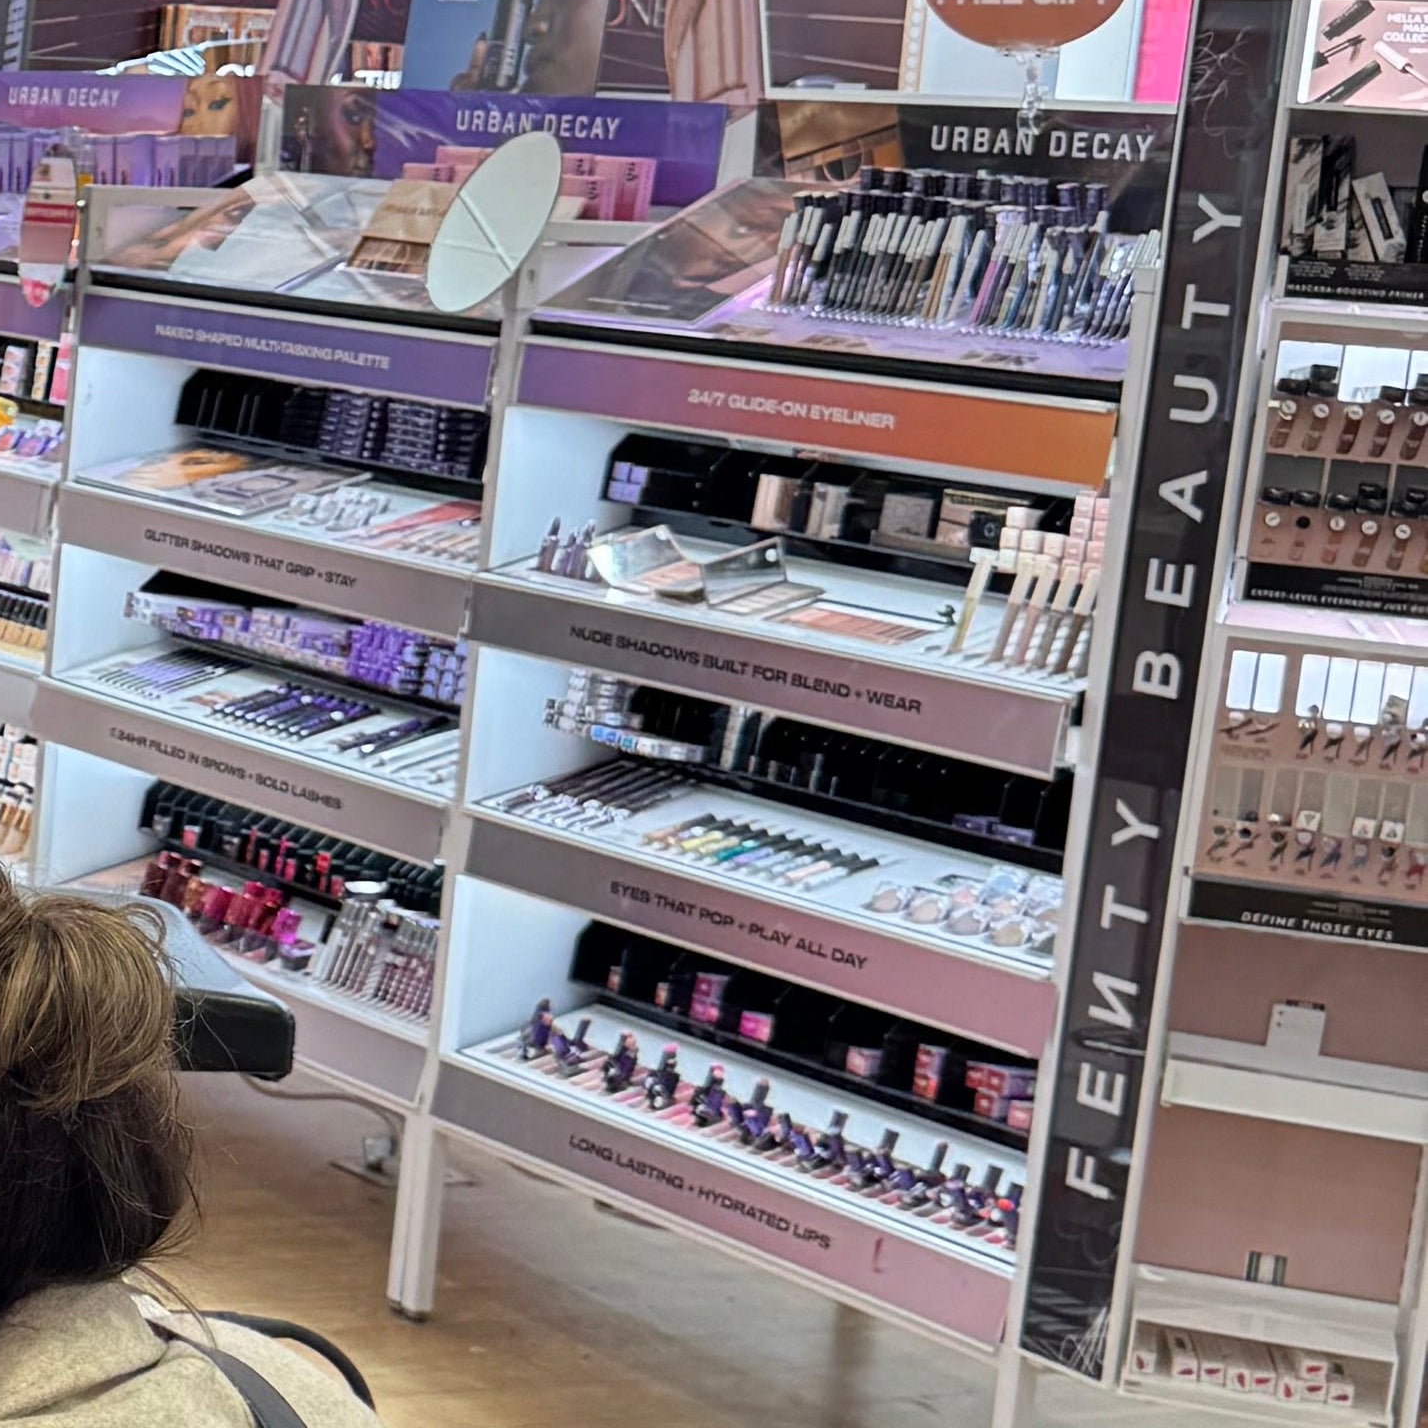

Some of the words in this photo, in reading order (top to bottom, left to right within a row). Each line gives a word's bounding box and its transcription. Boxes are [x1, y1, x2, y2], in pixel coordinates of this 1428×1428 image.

[8, 86, 63, 105] URBAN
[67, 88, 121, 107] DECAY
[455, 108, 538, 135] URBAN
[543, 113, 621, 141] DECAY
[930, 124, 1034, 157] URBAN
[1047, 129, 1156, 162] DECAY
[155, 324, 194, 341] NAKED
[196, 329, 242, 347] SHAPED
[334, 350, 390, 369] PALETTE
[687, 388, 725, 406] 24/7
[728, 394, 808, 418] GLIDE-ON
[810, 404, 896, 430] EYELINER
[1131, 193, 1244, 701] BEAUTY
[144, 528, 190, 549] GLITTER
[191, 538, 252, 563] SHADOWS
[253, 553, 284, 571] THAT
[285, 562, 316, 578] GRIP
[324, 571, 357, 588] STAY
[569, 625, 613, 647] NUDE
[615, 634, 700, 666] SHADOWS
[702, 653, 749, 676] BUILT
[751, 664, 788, 684] FOR
[790, 672, 851, 699] BLEND
[866, 689, 923, 714] WEAR
[148, 739, 186, 760] FILLED
[201, 756, 246, 780] BROWS
[291, 785, 343, 810] LASHES
[611, 881, 651, 904] EYES
[654, 893, 698, 917] THAT
[699, 907, 735, 927] POP
[748, 923, 793, 946] PLAY
[795, 938, 828, 959] ALL
[831, 947, 870, 970] DAY
[1241, 911, 1296, 928] DEFINE
[1301, 918, 1351, 936] THOSE
[1356, 926, 1394, 941] EYES
[1065, 798, 1164, 1201] FENTY
[569, 1134, 613, 1161] LONG
[615, 1152, 685, 1191] LASTING
[697, 1186, 792, 1233] HYDRATED
[793, 1223, 832, 1250] LIPS
